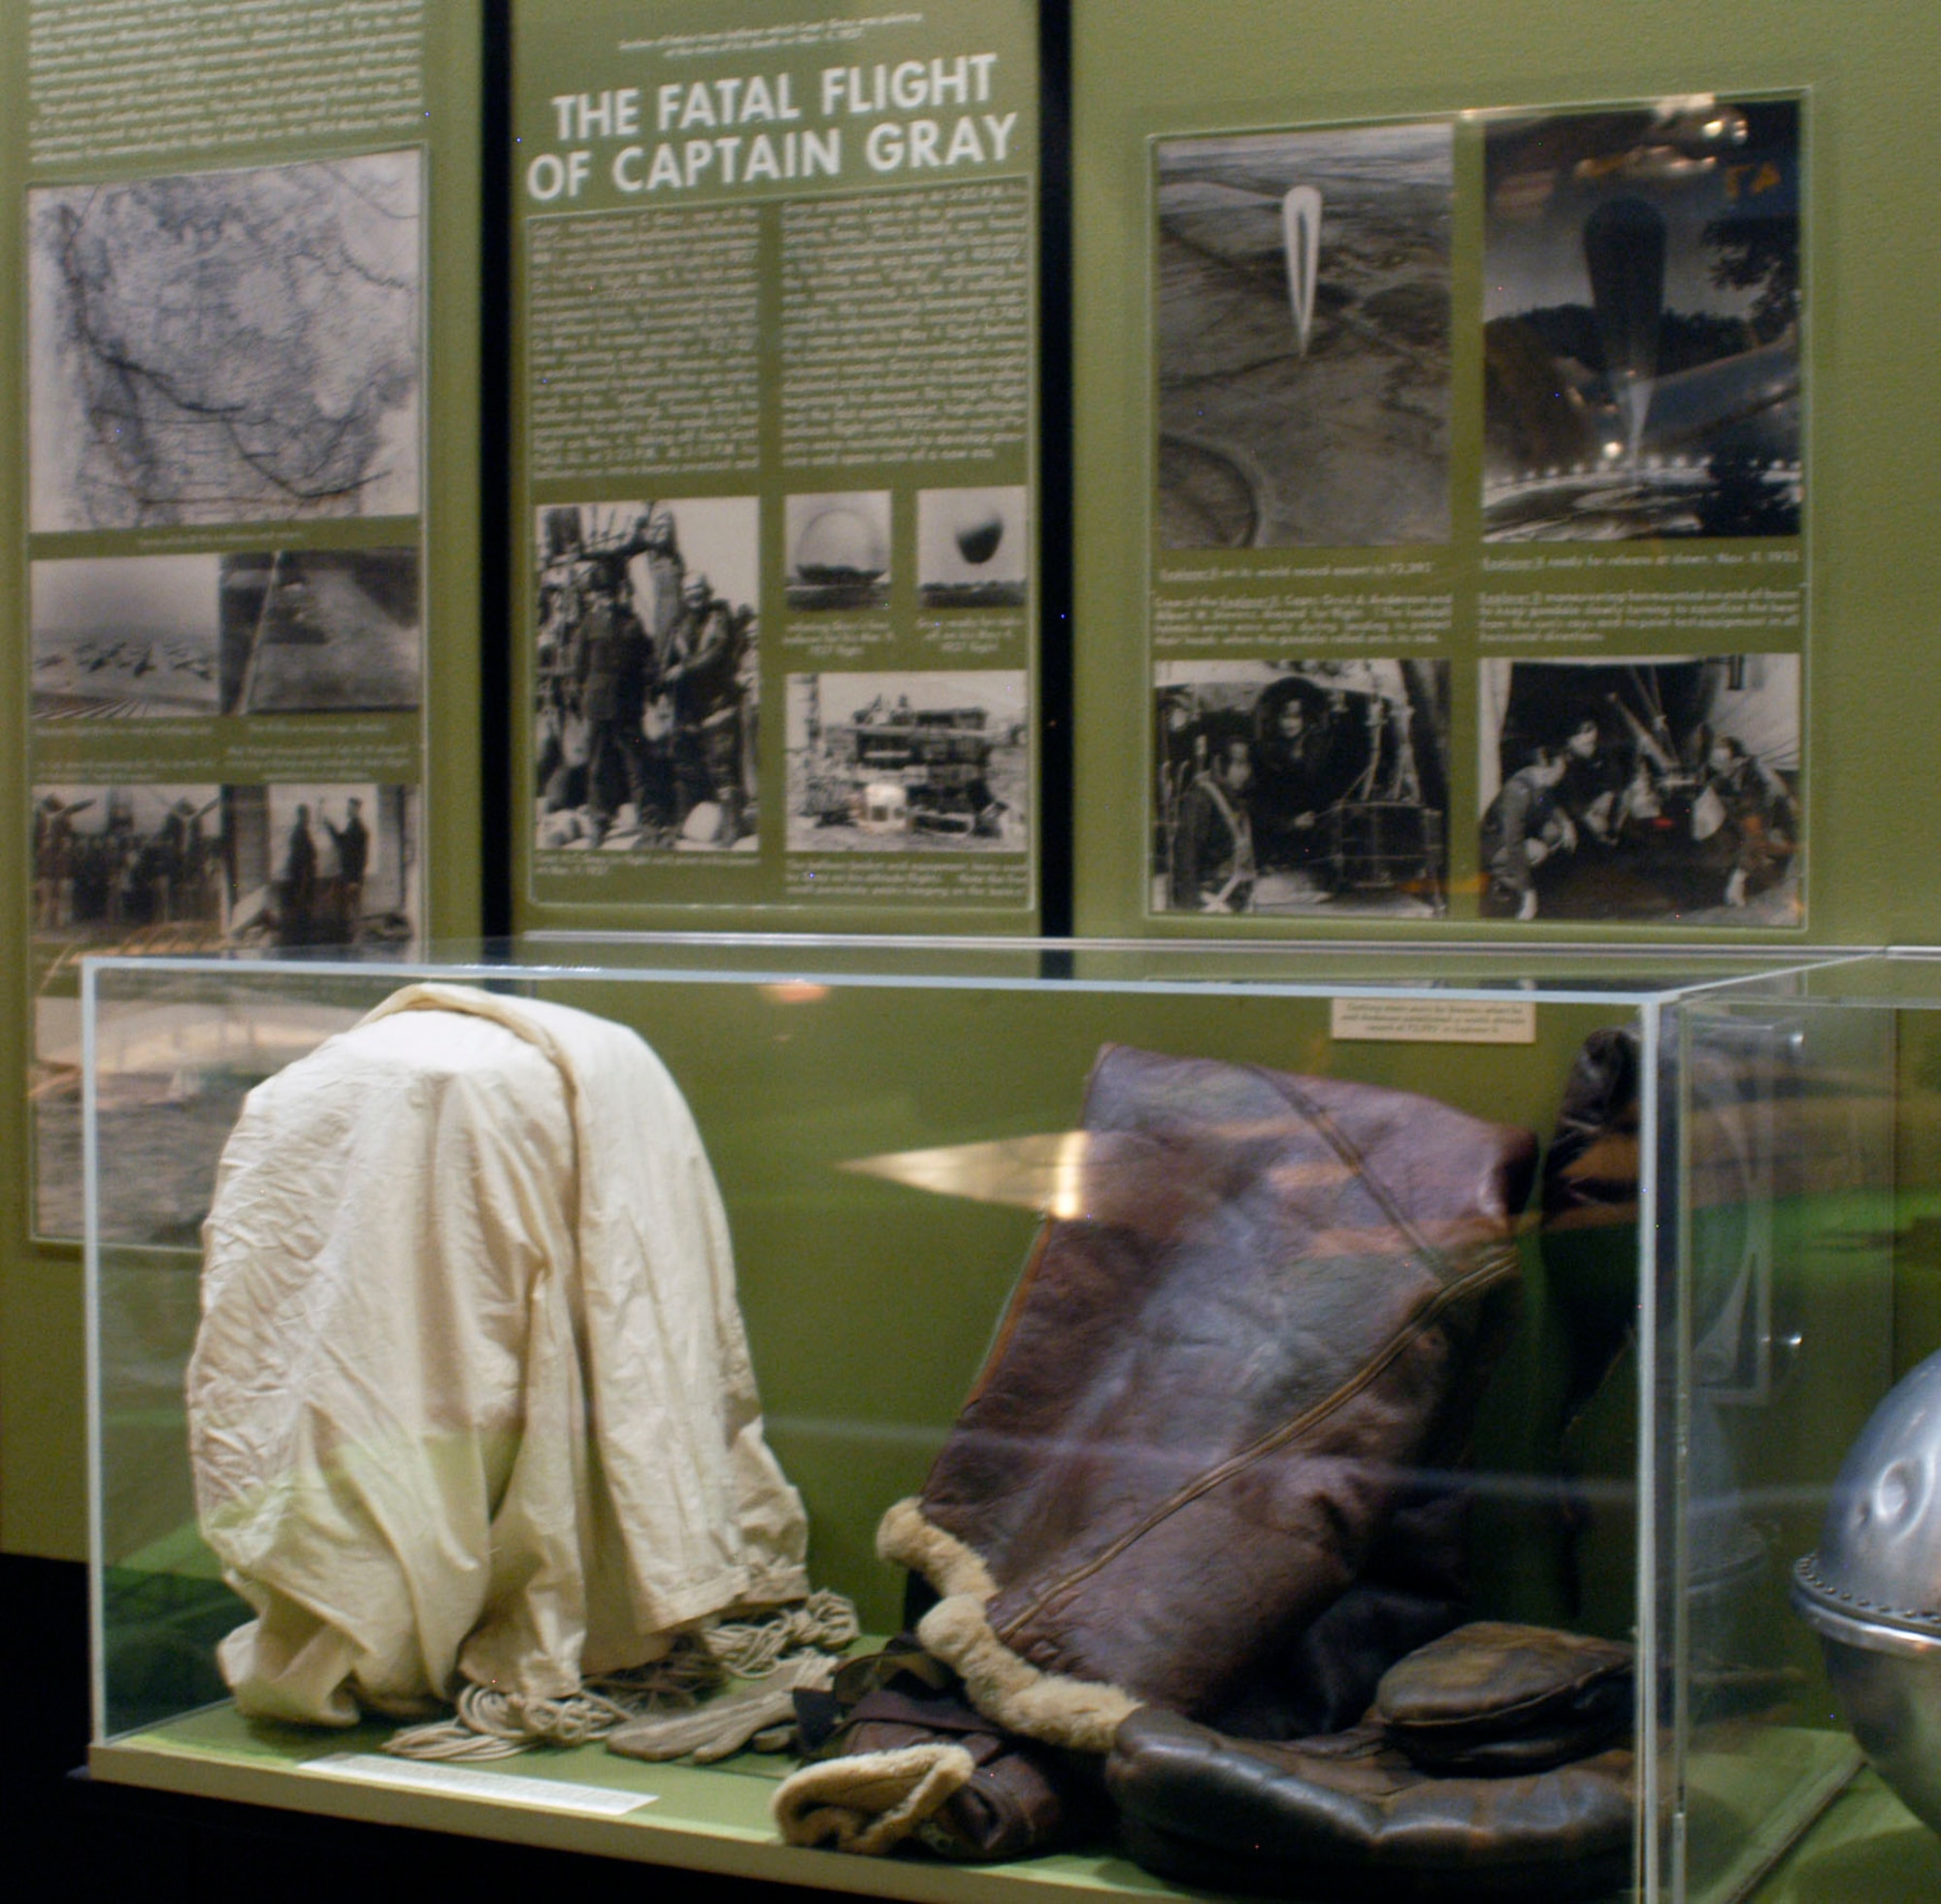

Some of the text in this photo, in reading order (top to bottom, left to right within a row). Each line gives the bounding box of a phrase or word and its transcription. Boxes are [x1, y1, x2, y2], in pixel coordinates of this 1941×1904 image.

[552, 52, 998, 141] THE FATAL FLIGHT
[526, 112, 1018, 201] OF CAPTAIN GRAY
